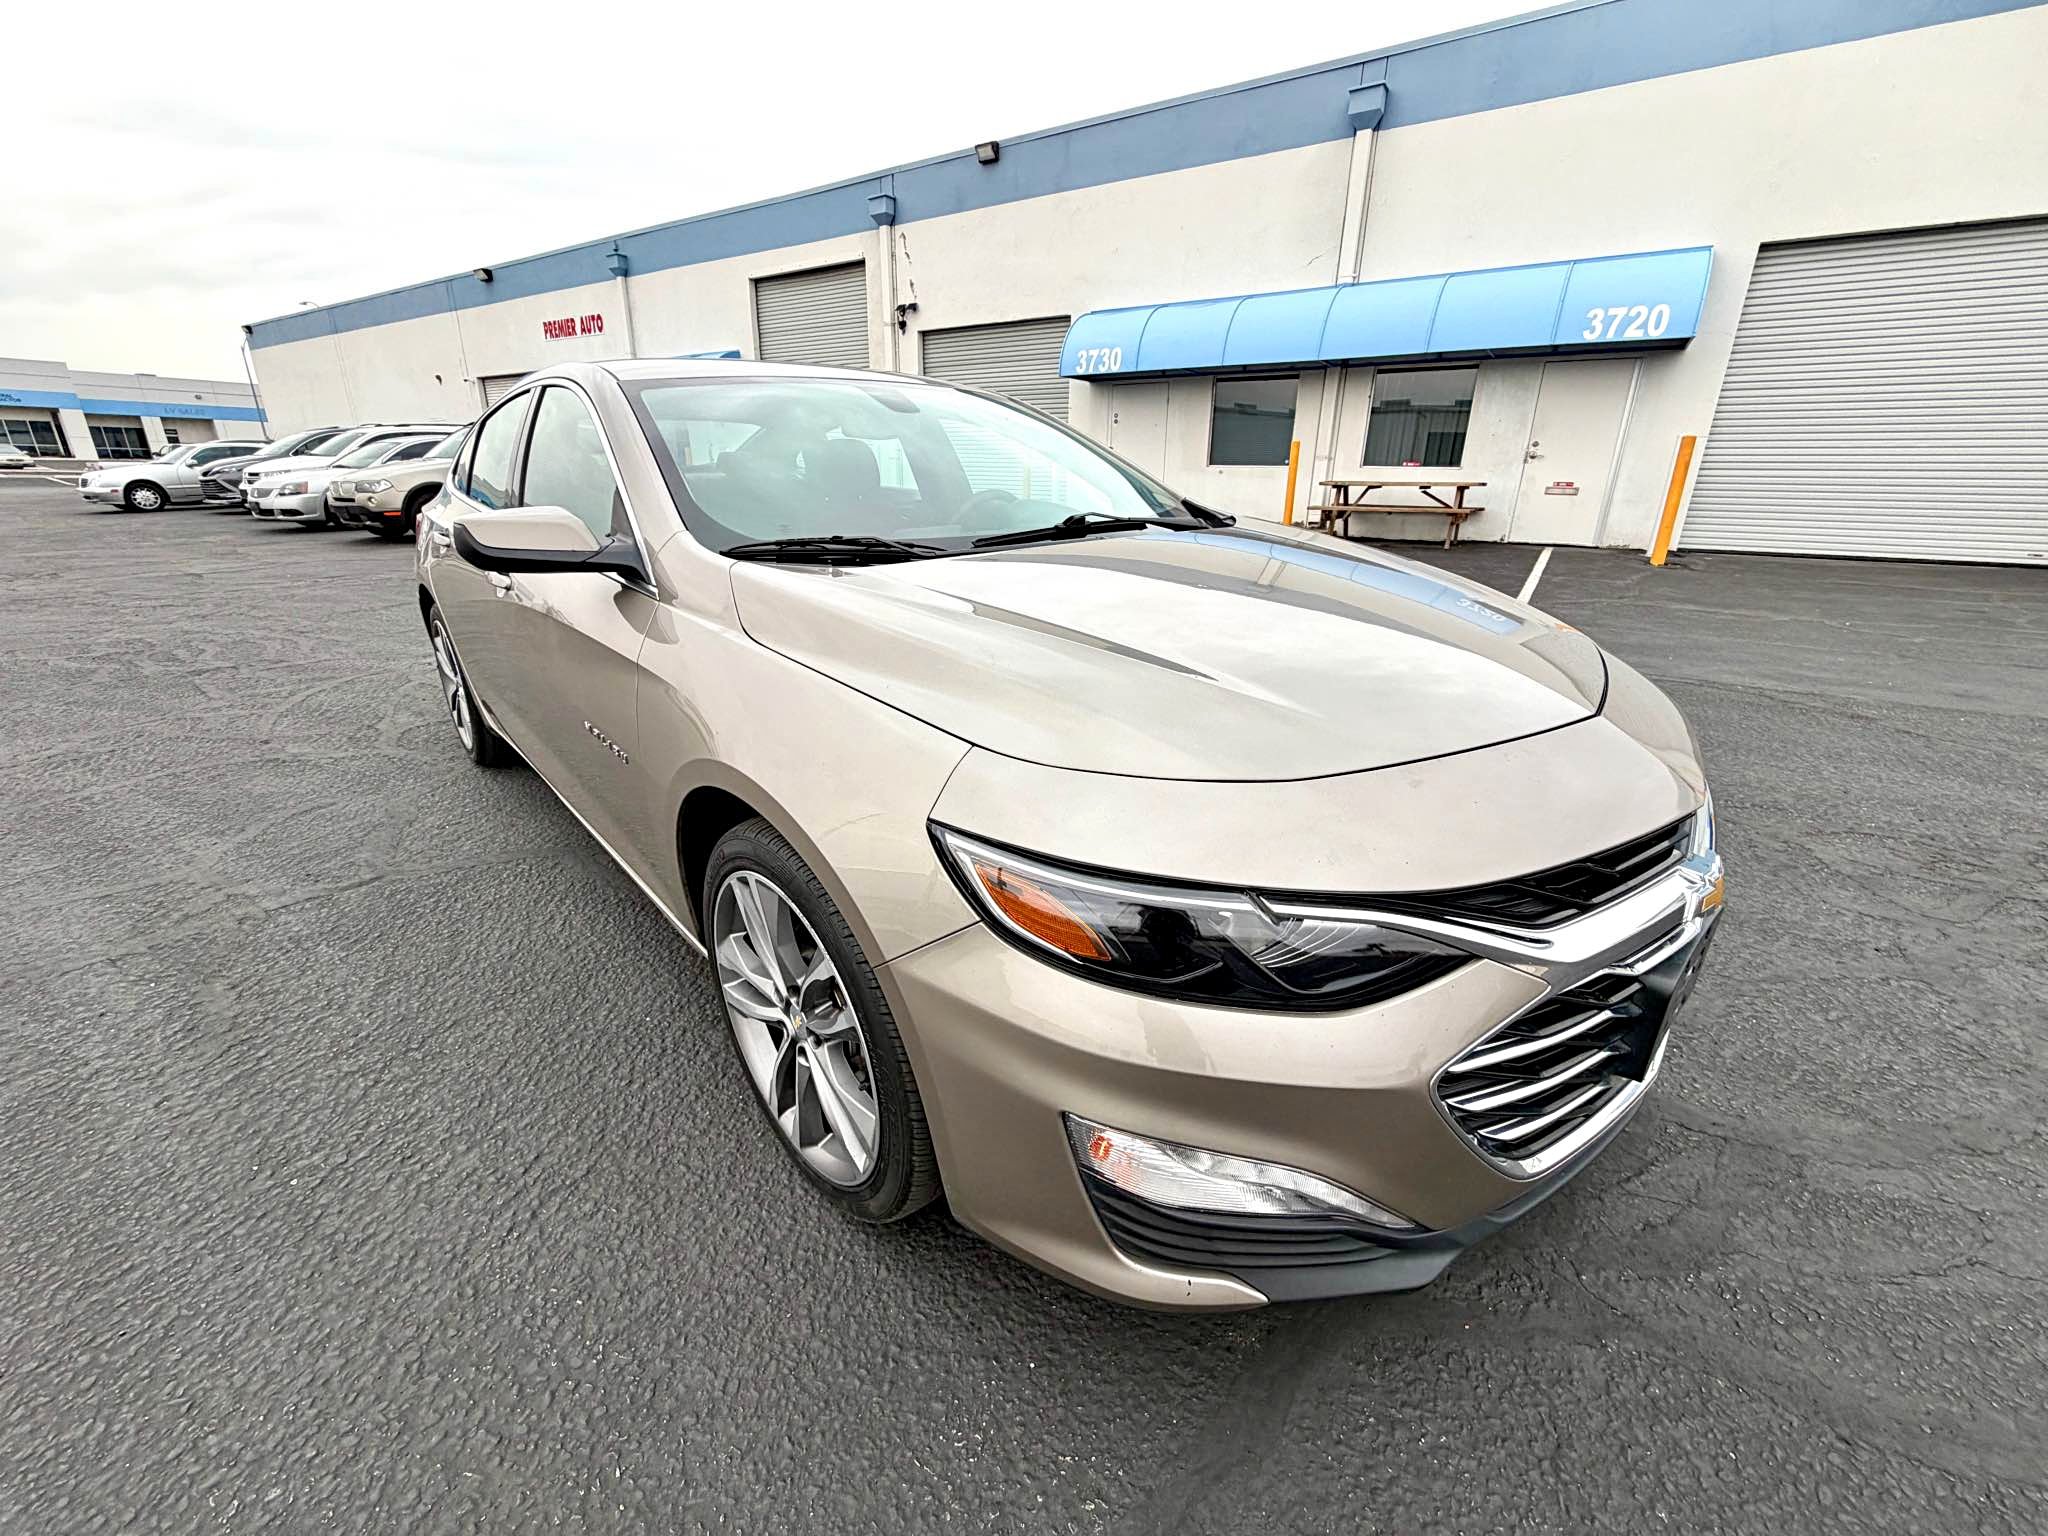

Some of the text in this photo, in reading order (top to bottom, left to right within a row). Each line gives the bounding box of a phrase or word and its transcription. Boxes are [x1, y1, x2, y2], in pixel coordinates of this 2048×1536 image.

[542, 314, 604, 340] PREMIER AUTO
[1583, 303, 1670, 340] 3720
[1076, 347, 1122, 374] 3730
